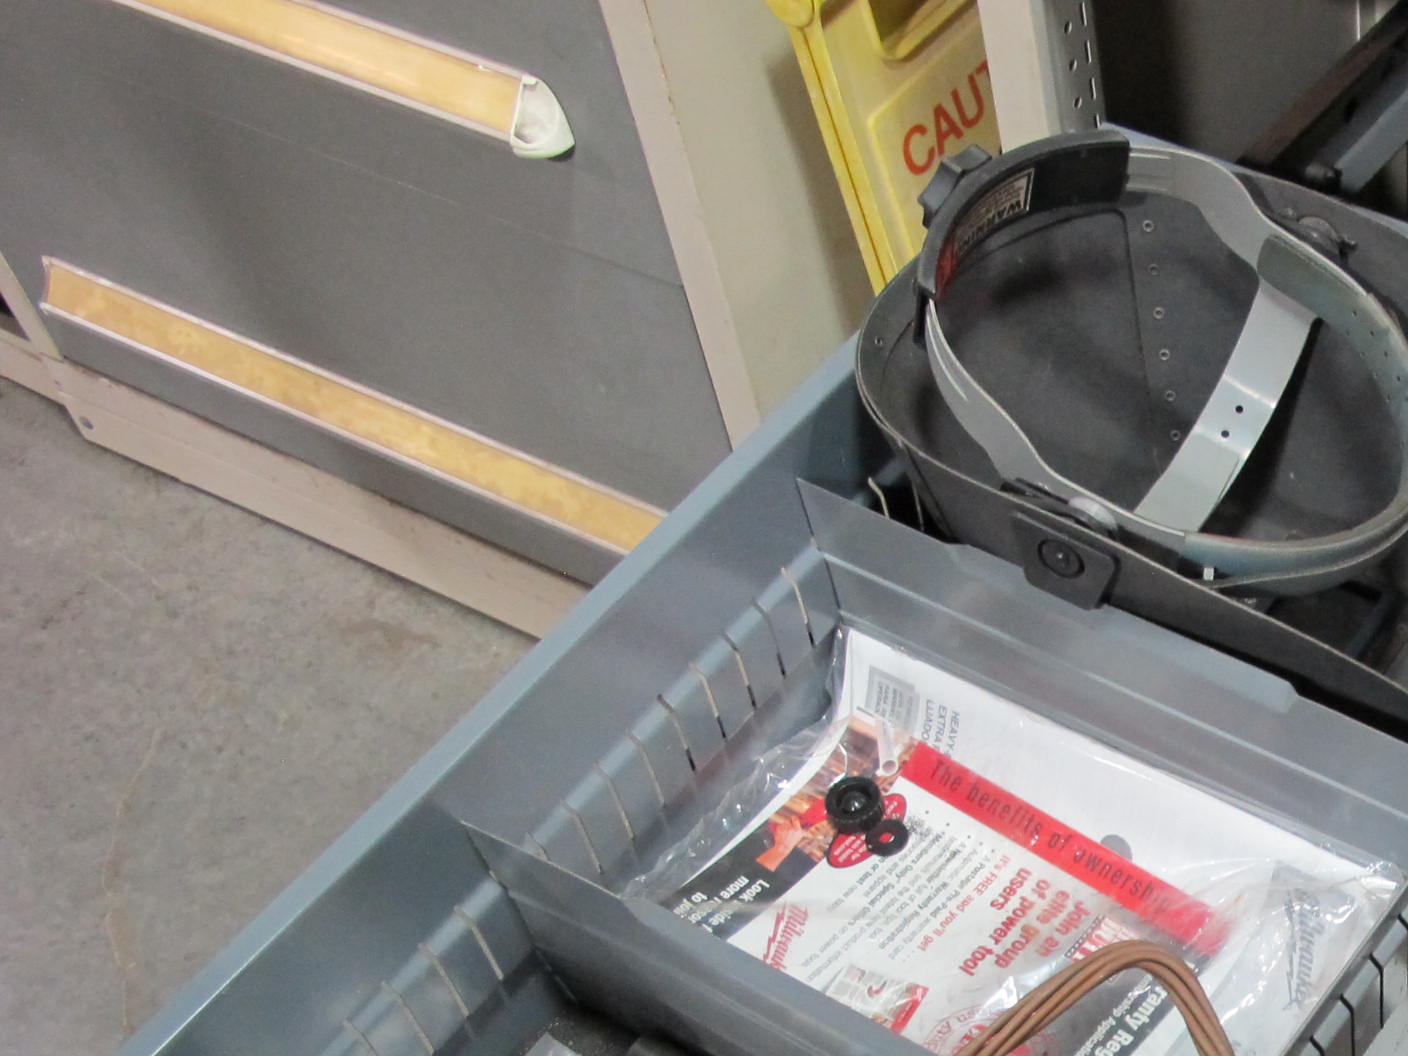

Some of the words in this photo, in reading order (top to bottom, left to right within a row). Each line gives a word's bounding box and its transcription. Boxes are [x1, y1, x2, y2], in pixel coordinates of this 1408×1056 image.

[929, 759, 963, 790] The
[966, 782, 1043, 839] benefits
[1045, 828, 1073, 856] of
[689, 890, 708, 904] to
[718, 874, 750, 900] more
[737, 878, 771, 902] Look
[971, 870, 998, 897] FREE
[988, 866, 1033, 912] users
[1030, 876, 1052, 900] of
[954, 894, 975, 913] and
[1034, 888, 1073, 928] elite
[931, 909, 959, 938] you'll
[987, 895, 1036, 946] power
[1053, 899, 1091, 942] Join
[916, 933, 934, 952] get
[992, 921, 1042, 973] group
[1034, 934, 1060, 959] an
[958, 943, 997, 977] tool
